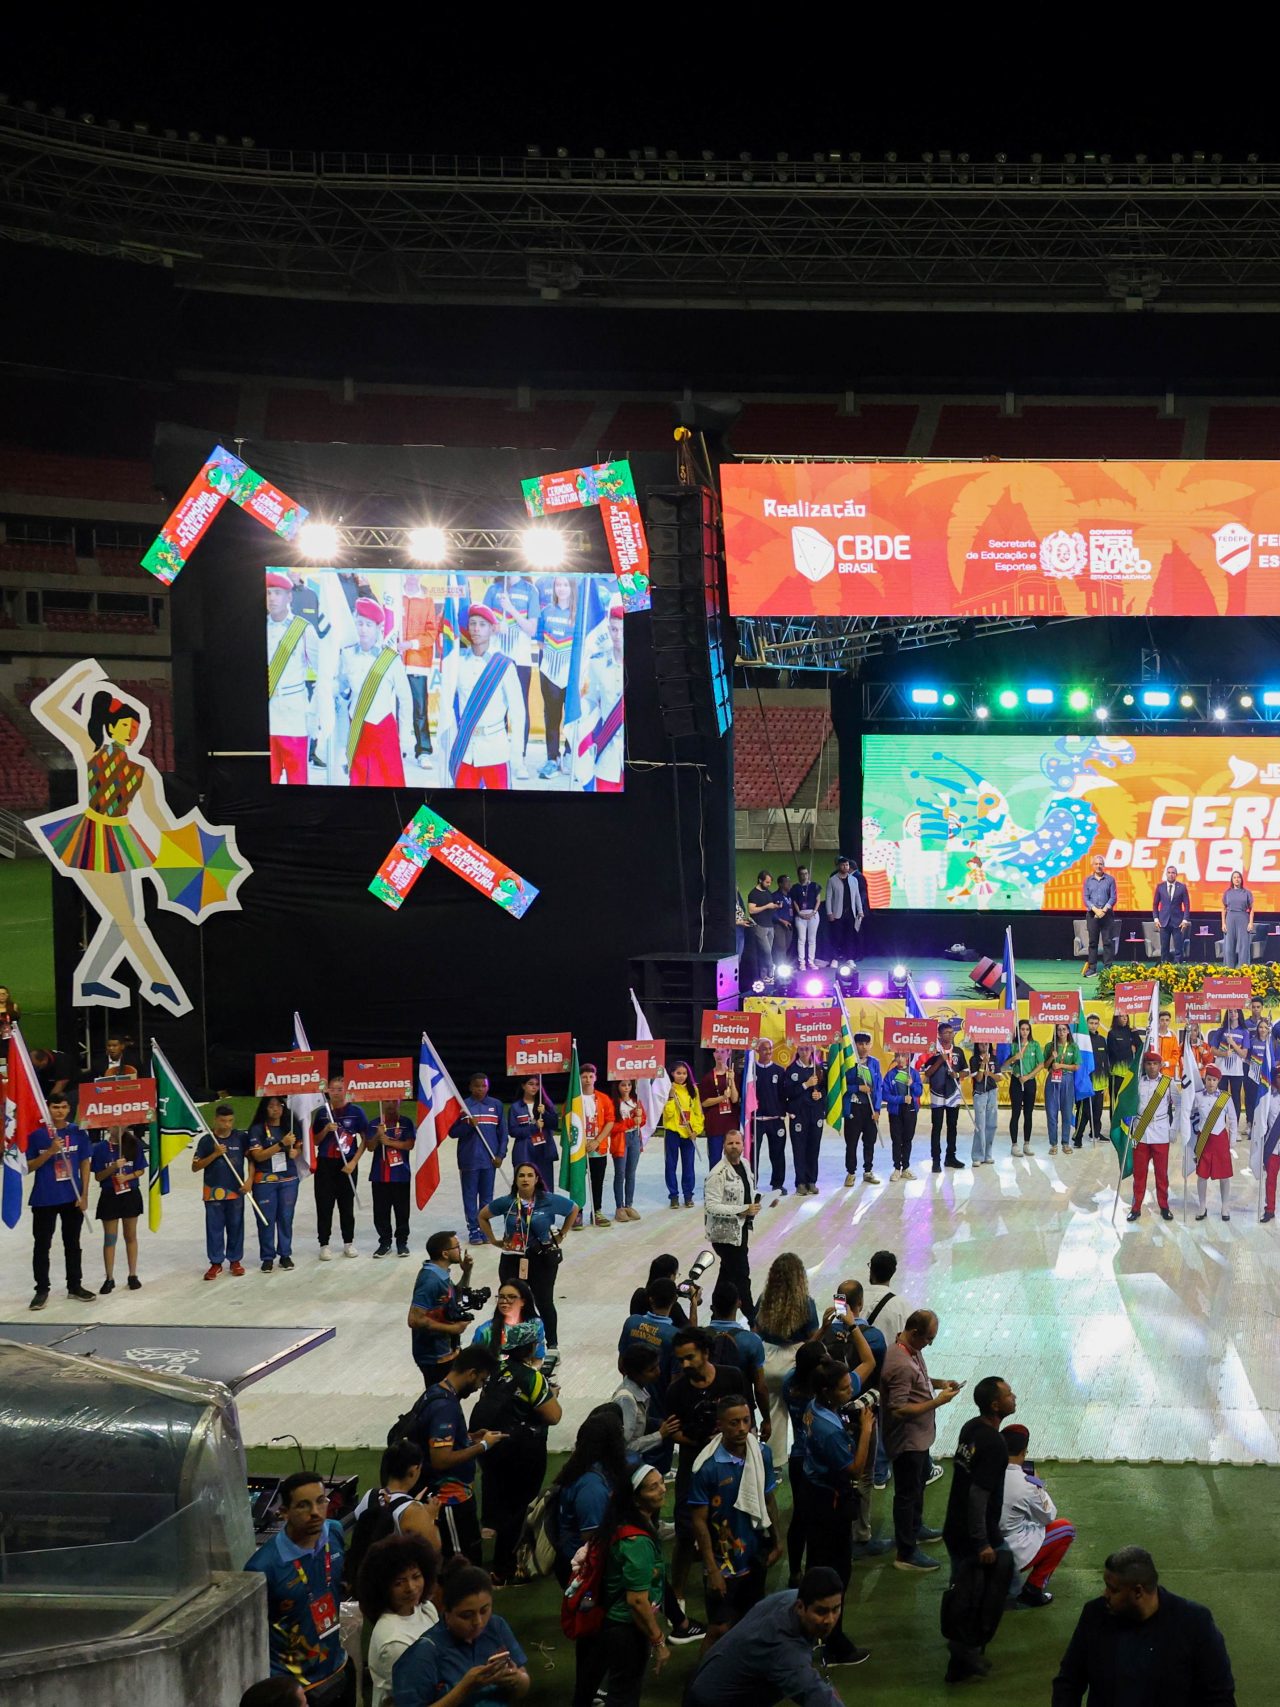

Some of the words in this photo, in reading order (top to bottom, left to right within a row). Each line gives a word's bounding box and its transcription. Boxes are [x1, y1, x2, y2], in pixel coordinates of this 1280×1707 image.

[763, 498, 866, 518] Realização
[837, 535, 911, 560] CBDE
[988, 540, 1036, 548] Secretaria
[966, 552, 979, 560] de
[981, 552, 1027, 561] Educação
[838, 563, 877, 574] BRASIL
[995, 563, 1037, 572] Esportes
[1104, 839, 1161, 869] DE
[1041, 1002, 1067, 1011] Mato
[1185, 1002, 1210, 1010] Mina
[1038, 1012, 1070, 1022] Grosso
[712, 1023, 750, 1034] Distrito
[795, 1021, 832, 1032] Espírito
[969, 1024, 1010, 1034] Maranhão
[711, 1035, 749, 1045] Federal
[800, 1033, 828, 1042] Santo
[892, 1031, 928, 1045] Goiás
[516, 1050, 563, 1065] Bahia
[616, 1055, 657, 1070] Ceará
[264, 1069, 320, 1088] Amapá
[347, 1077, 411, 1091] Amazonas
[86, 1095, 150, 1117] Alagoas
